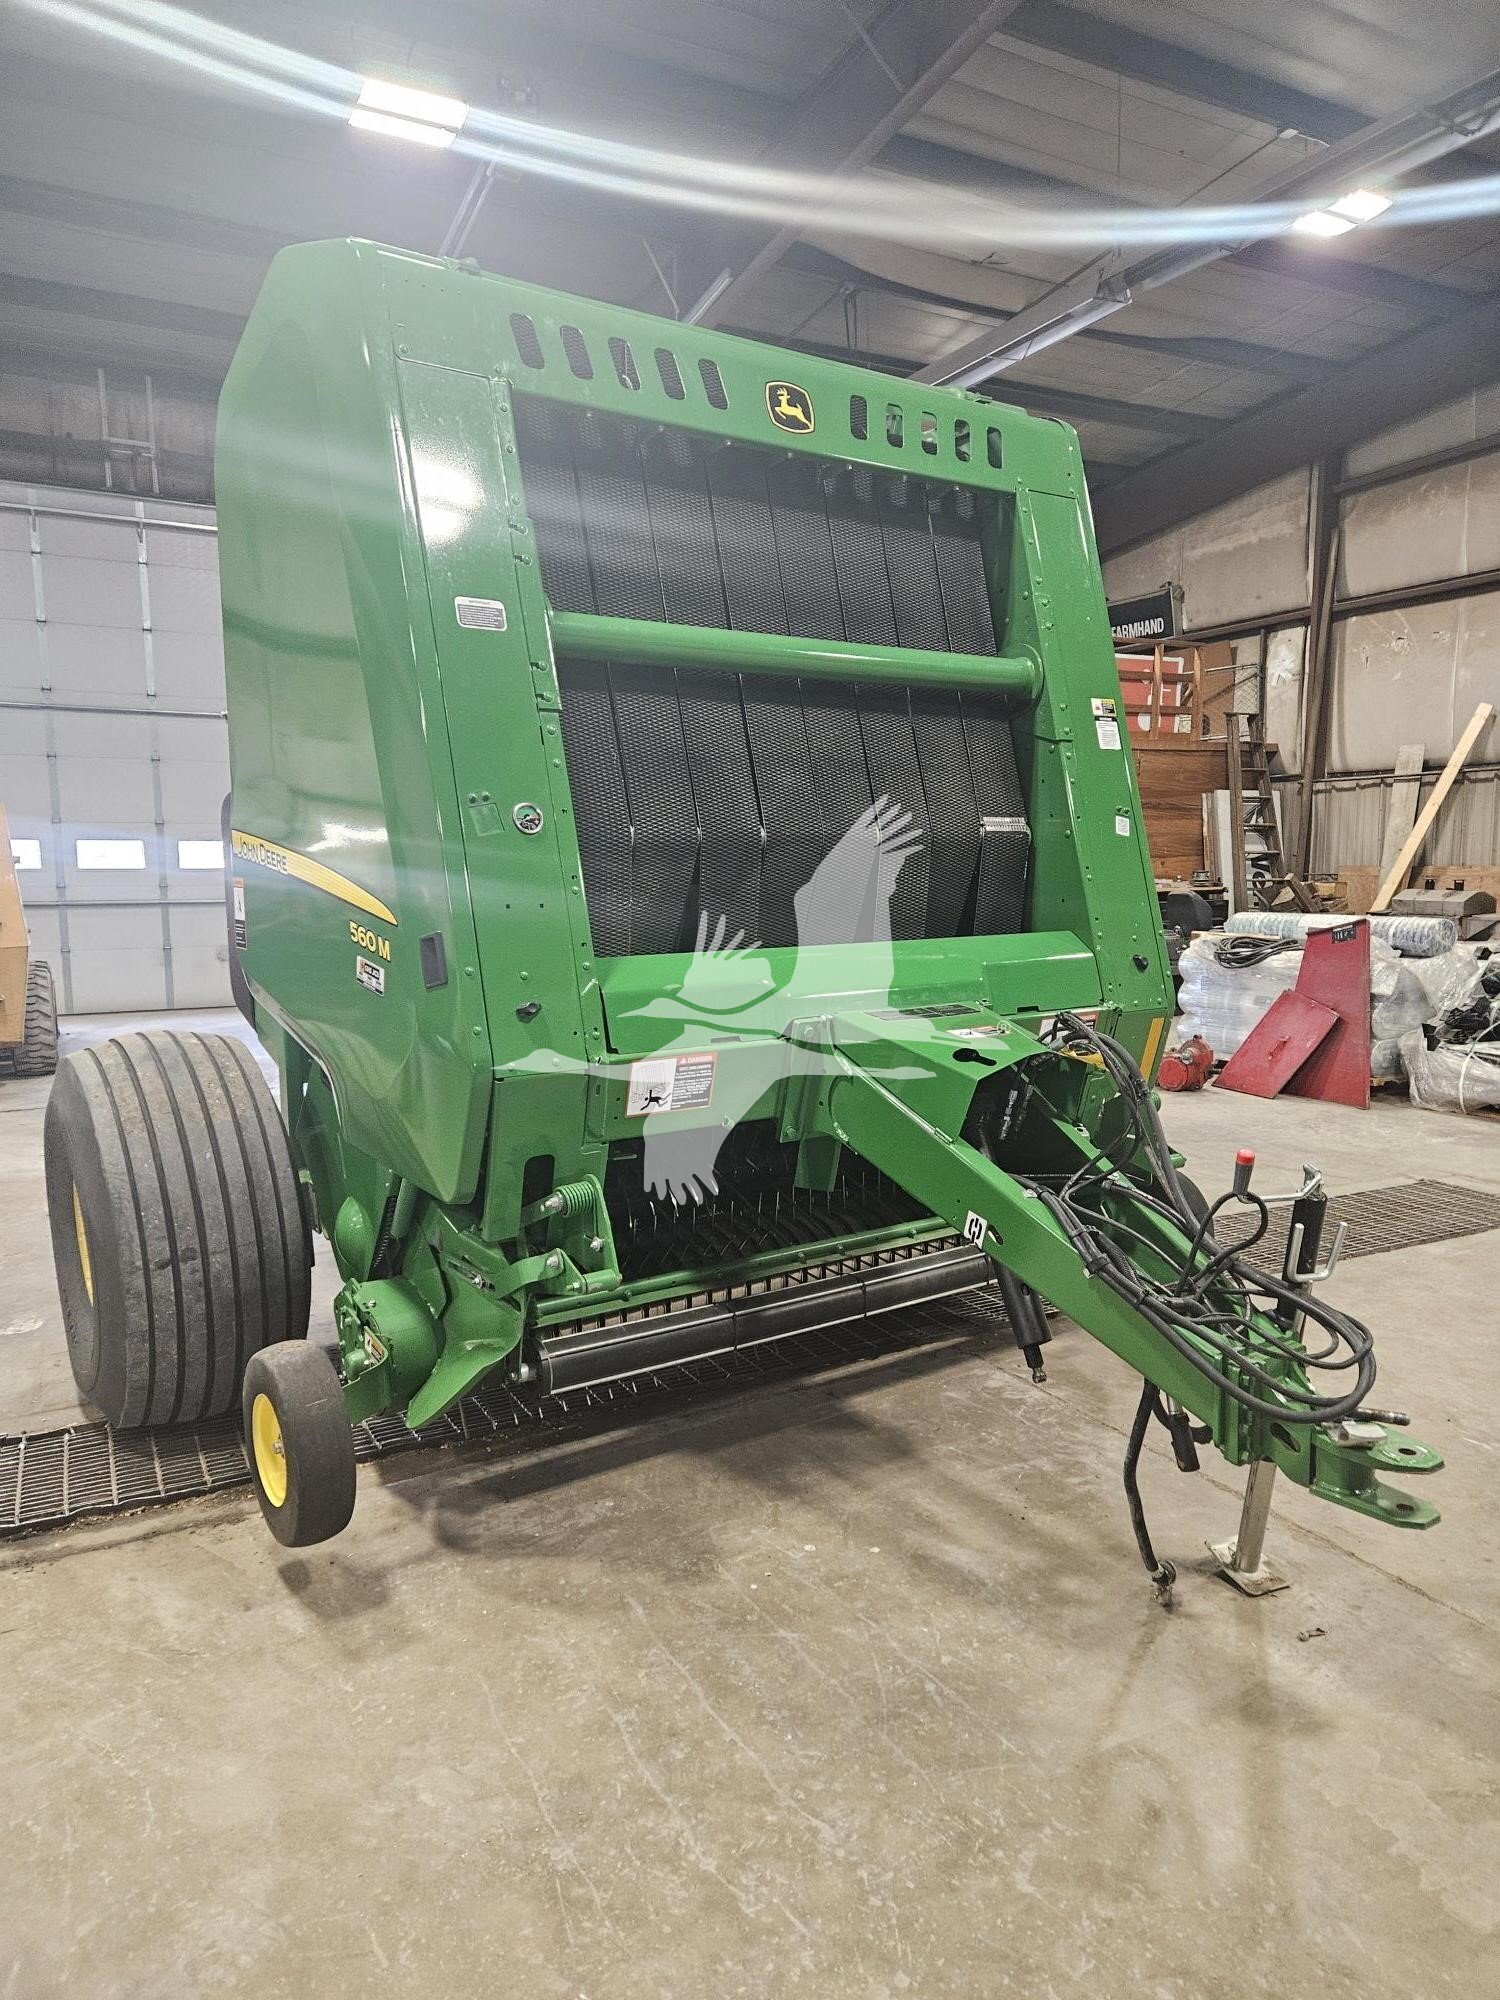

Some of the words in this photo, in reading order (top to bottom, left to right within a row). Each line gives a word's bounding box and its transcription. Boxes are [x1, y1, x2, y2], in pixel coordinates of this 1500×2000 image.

[1111, 617, 1164, 638] FARMHAND
[260, 843, 288, 873] DEERE
[349, 920, 376, 952] 560
[377, 935, 391, 962] M
